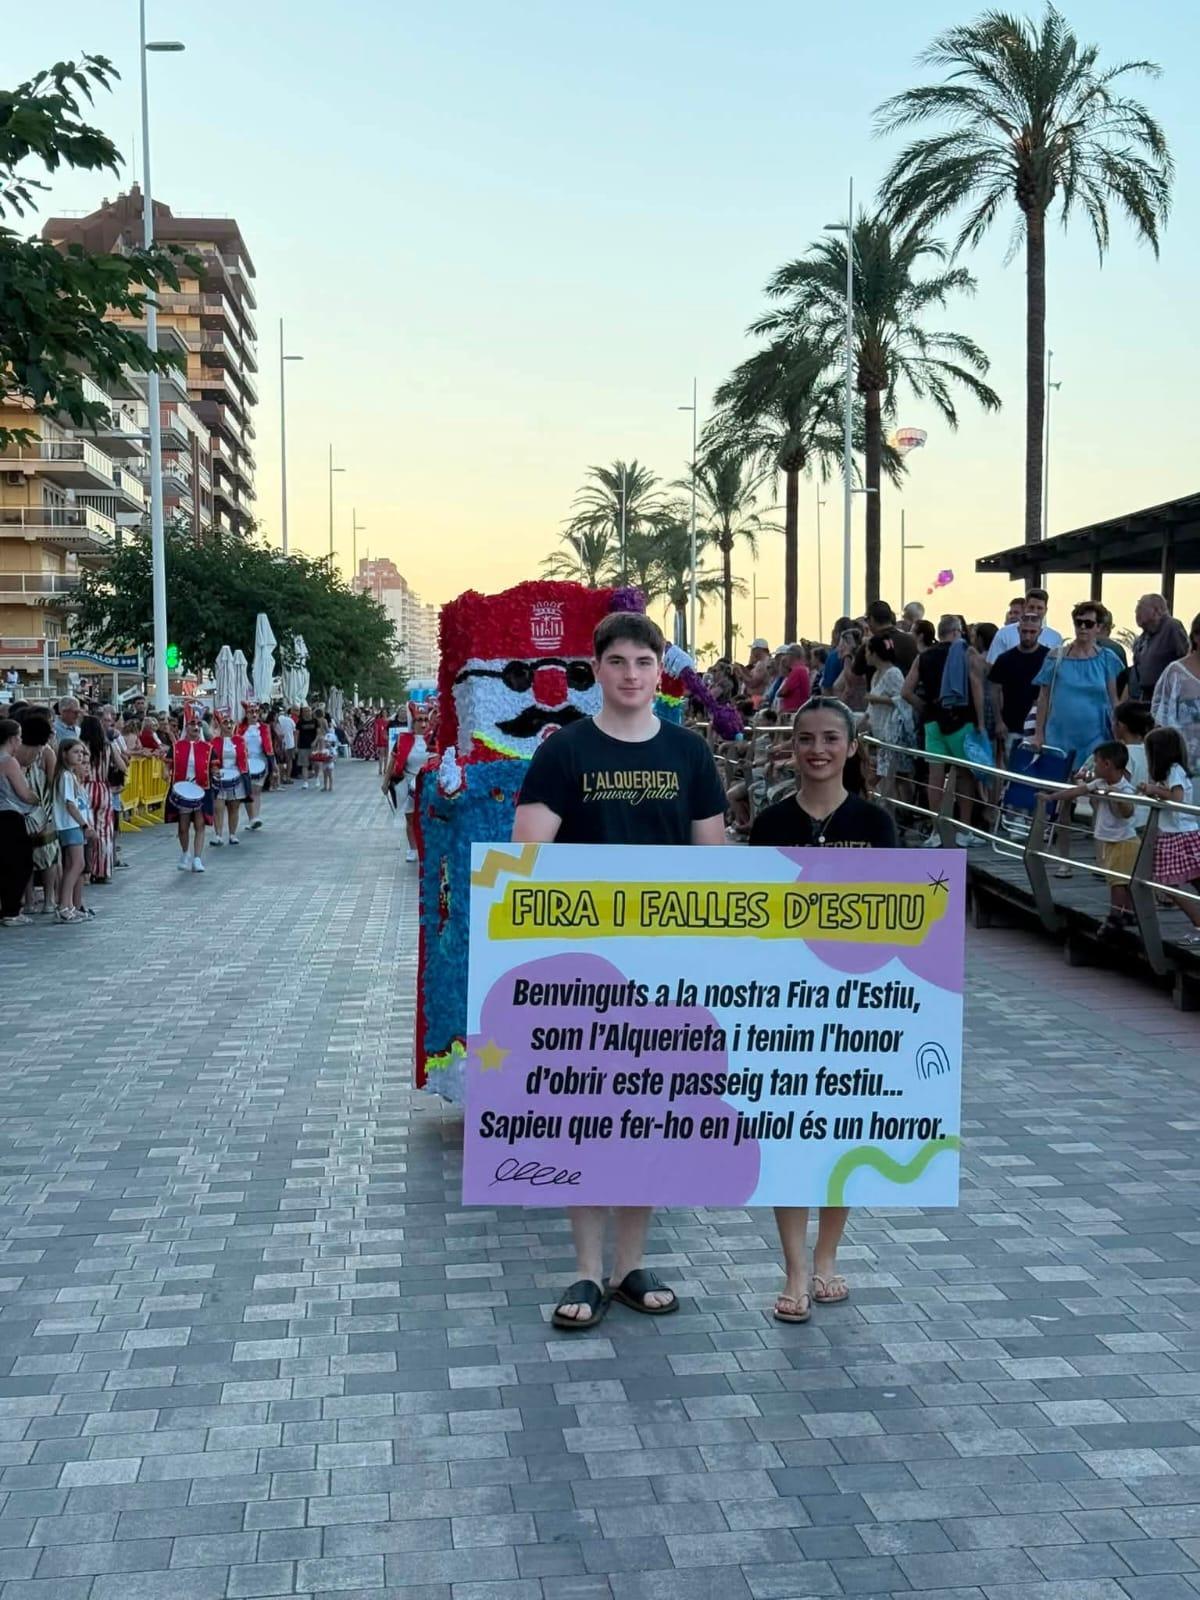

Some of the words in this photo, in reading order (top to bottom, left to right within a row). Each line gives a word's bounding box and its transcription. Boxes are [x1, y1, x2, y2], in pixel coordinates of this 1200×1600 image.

[582, 770, 680, 792] L'ALQUERIETA
[512, 888, 600, 927] FIRA
[613, 890, 626, 928] I
[640, 890, 770, 929] FALLES
[784, 891, 925, 931] D’ESTIU
[512, 977, 649, 1014] Benvinguts
[653, 984, 667, 1008] a
[675, 978, 698, 1007] la
[704, 980, 780, 1008] nostra
[787, 980, 830, 1008] Fira
[836, 980, 921, 1013] d'Estiu,
[530, 1027, 584, 1051] som
[589, 1021, 727, 1058] l’Alquerieta
[732, 1023, 741, 1052] i
[747, 1023, 815, 1052] tenim
[820, 1023, 904, 1053] l'honor
[526, 1065, 607, 1095] d’obrir
[612, 1067, 664, 1096] este
[668, 1067, 764, 1103] passeig
[770, 1068, 808, 1096] tan
[815, 1066, 903, 1096] festiu...
[479, 1110, 563, 1145] Sapieu
[568, 1115, 613, 1146] que
[620, 1109, 694, 1140] fer-ho
[699, 1116, 730, 1140] en
[733, 1111, 795, 1146] juliol
[799, 1110, 828, 1140] és
[833, 1117, 863, 1140] un
[869, 1111, 946, 1140] horror.
